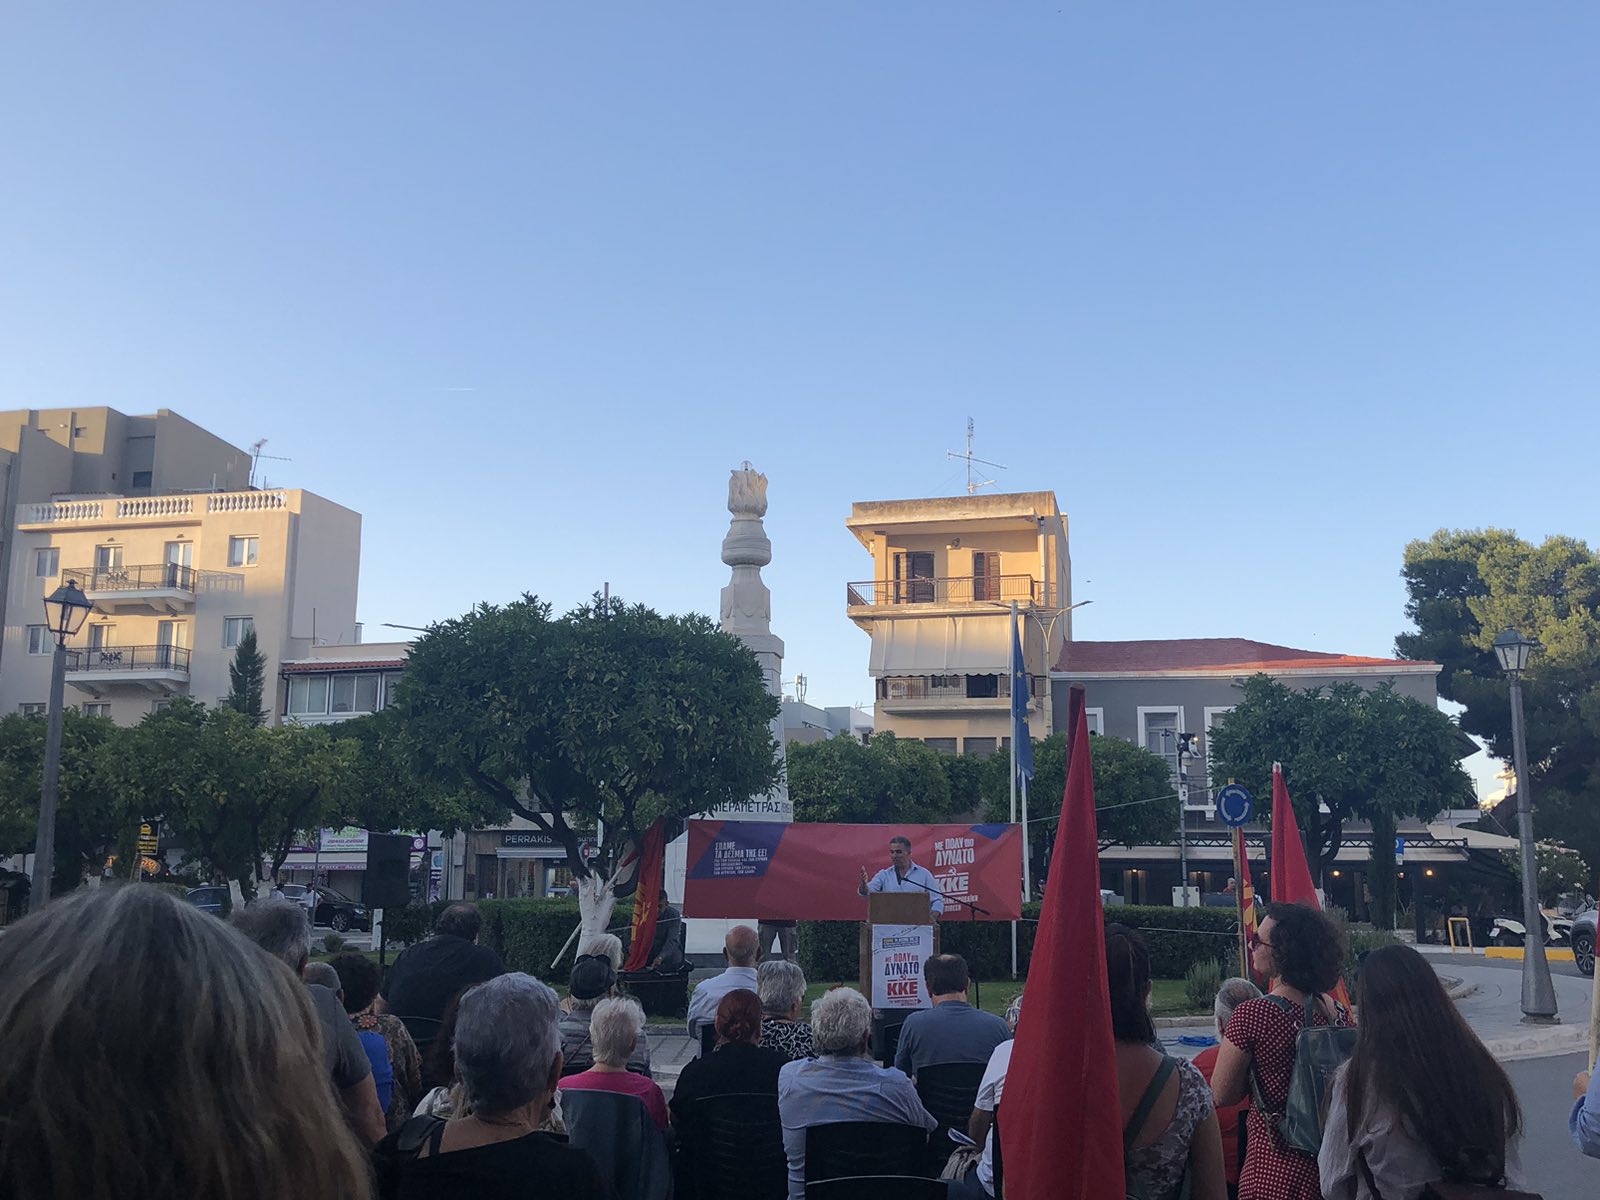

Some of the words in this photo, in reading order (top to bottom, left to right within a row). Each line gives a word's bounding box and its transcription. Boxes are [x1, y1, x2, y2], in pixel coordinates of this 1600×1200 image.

[505, 834, 553, 843] PERRAKIS
[715, 841, 736, 850] ΣΠΑΜΕ
[945, 837, 964, 850] ΠΟΛΥ
[935, 847, 975, 867] ΔΥΝΑΤΟ
[934, 876, 969, 893] ΚΚΕ
[893, 953, 911, 962] ΠΟΛΥ
[884, 961, 919, 976] ΔΥΝΑΤΟ
[887, 981, 918, 996] ΚΚΕ
